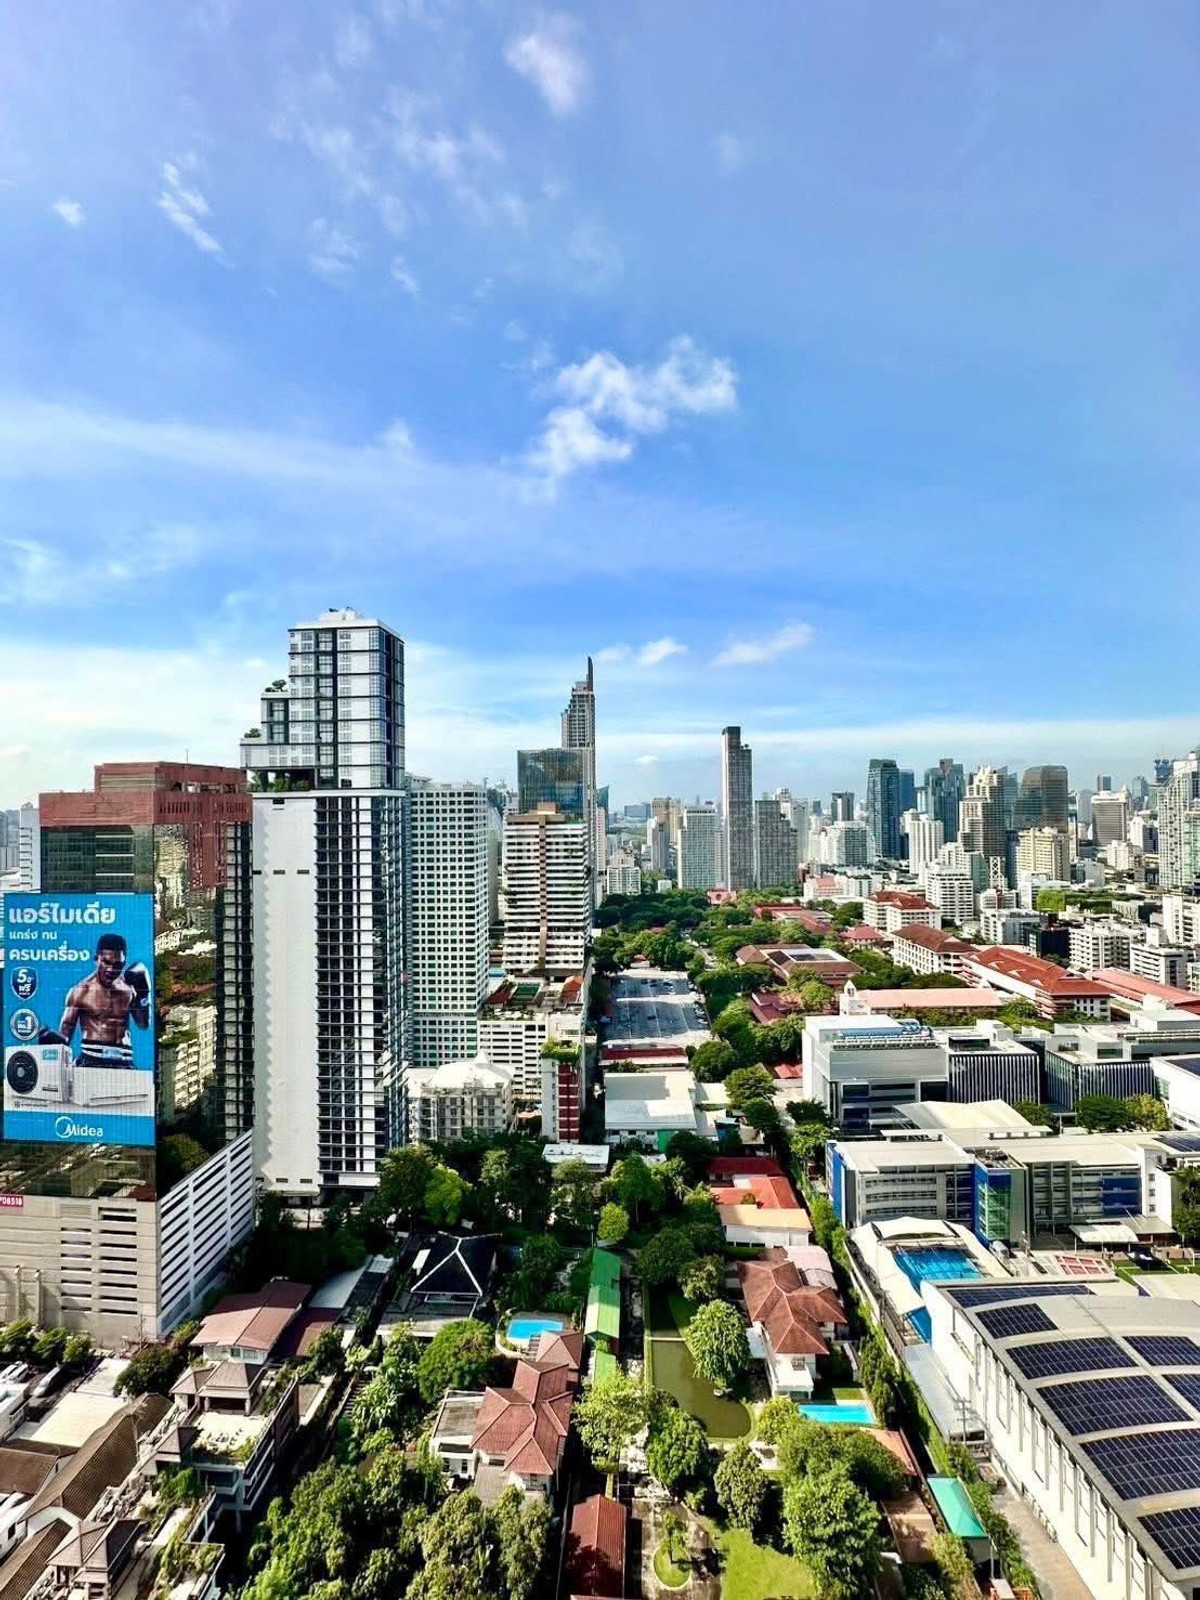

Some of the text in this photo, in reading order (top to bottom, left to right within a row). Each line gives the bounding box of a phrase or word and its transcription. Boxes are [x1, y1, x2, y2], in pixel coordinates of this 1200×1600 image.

[9, 901, 116, 924] แอร์ไมเดีย
[9, 928, 38, 940] แกร่ง
[9, 940, 90, 961] ครบเครื่อง
[56, 1116, 103, 1138] Midea
